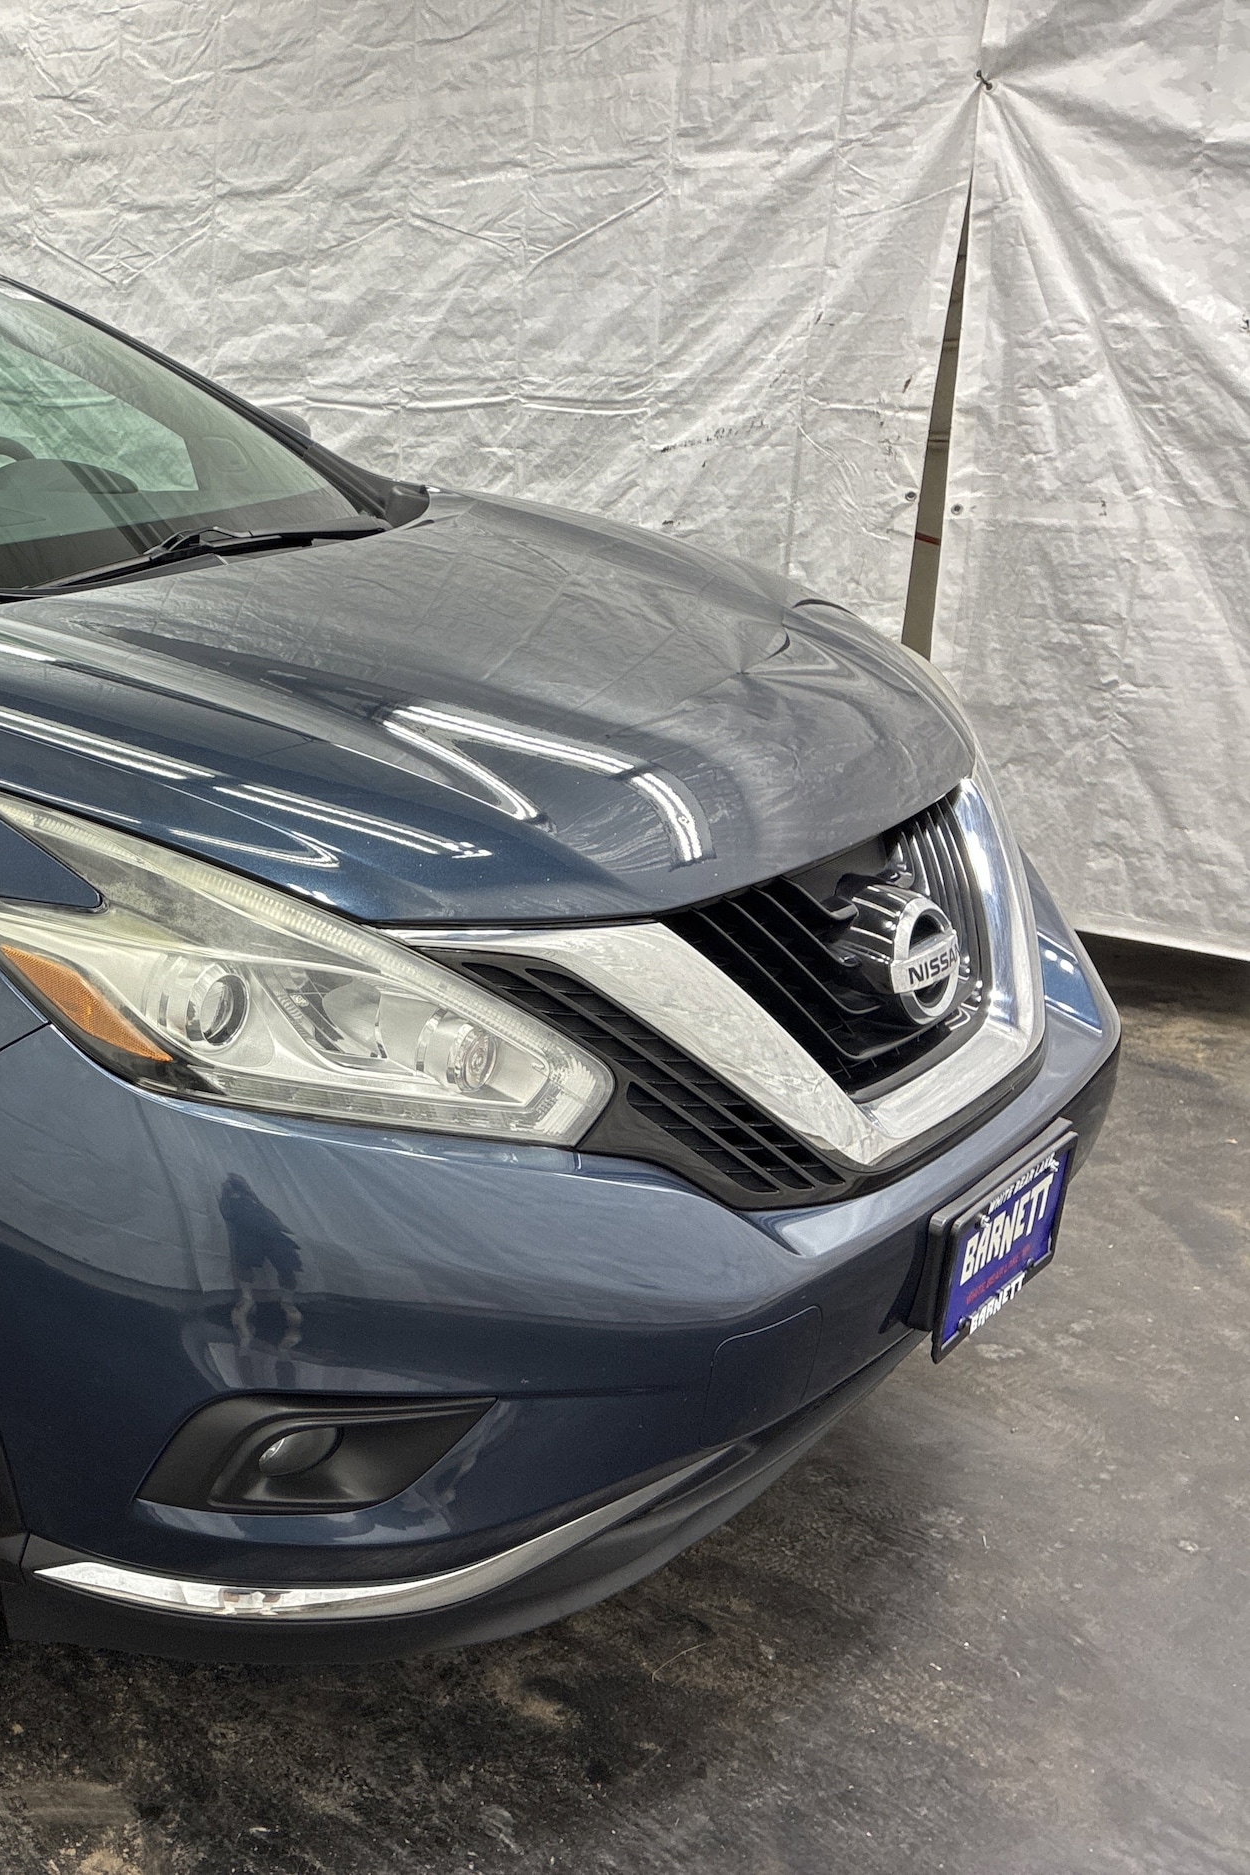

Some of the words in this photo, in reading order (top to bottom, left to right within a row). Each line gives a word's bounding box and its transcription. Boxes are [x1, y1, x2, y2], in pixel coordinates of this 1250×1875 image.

[908, 944, 960, 984] NISSAN
[988, 1184, 1015, 1215] WHITE
[1013, 1168, 1035, 1195] BEAR
[960, 1173, 1054, 1287] BARNETT
[969, 1272, 1026, 1334] BARNETT
